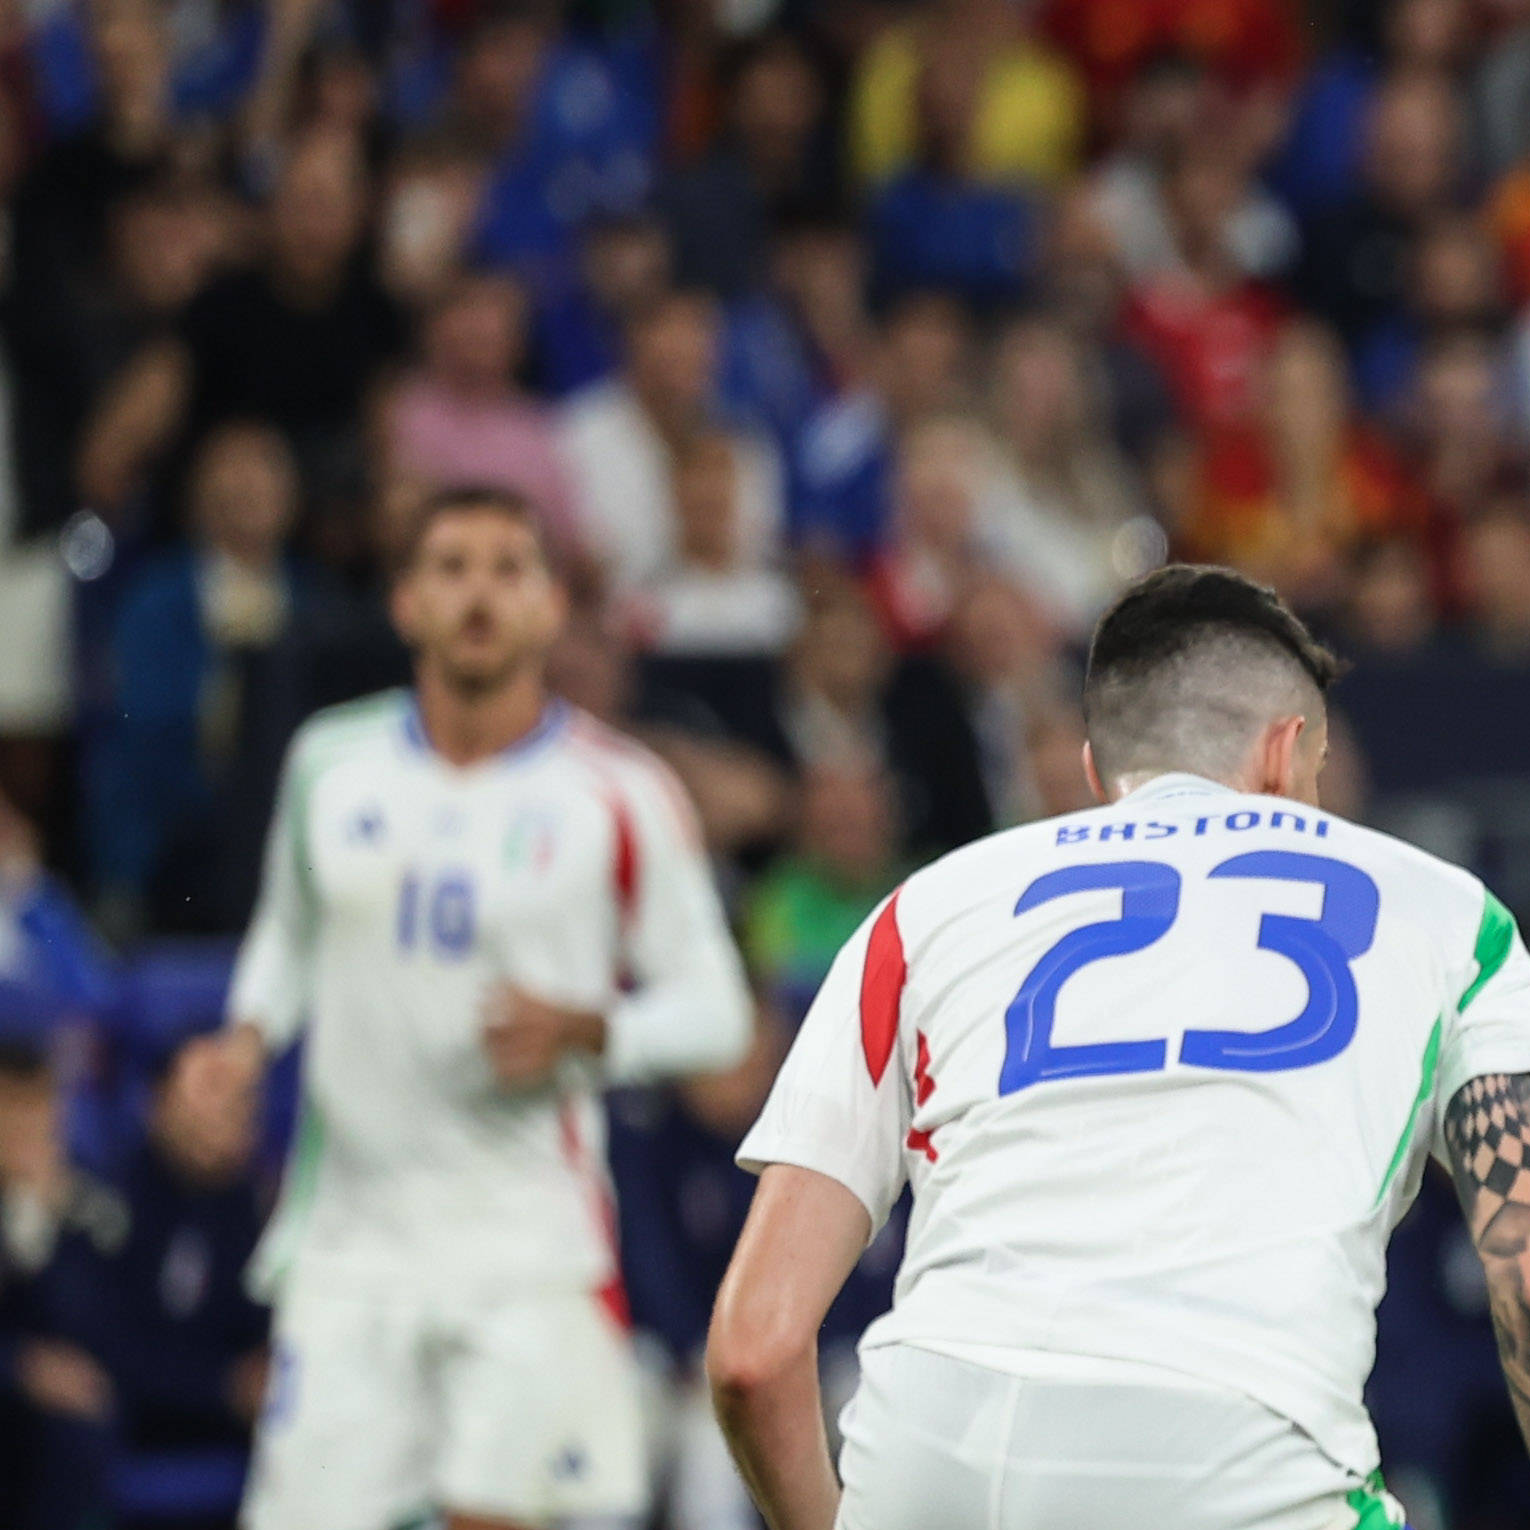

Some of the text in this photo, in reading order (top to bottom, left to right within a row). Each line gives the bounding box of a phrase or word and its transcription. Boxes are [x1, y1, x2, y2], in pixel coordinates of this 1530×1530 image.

[1055, 810, 1329, 845] BASTONI
[398, 868, 476, 958] 10
[999, 849, 1380, 1097] 23
